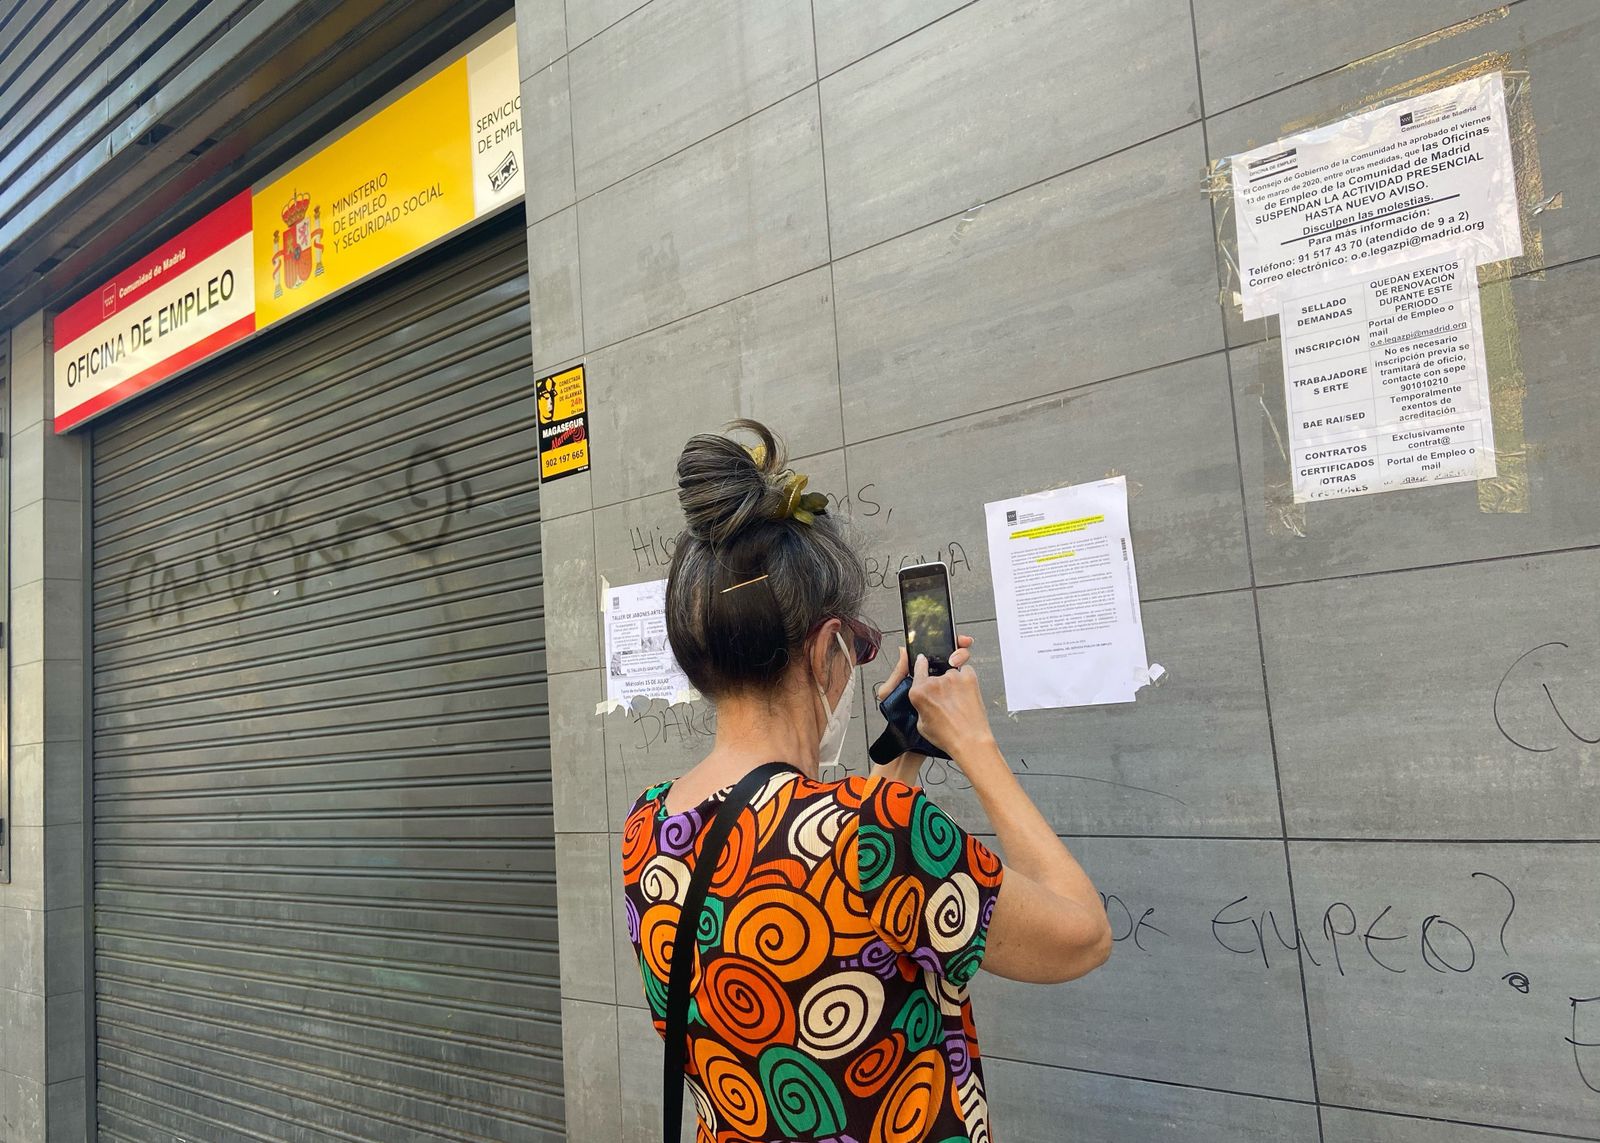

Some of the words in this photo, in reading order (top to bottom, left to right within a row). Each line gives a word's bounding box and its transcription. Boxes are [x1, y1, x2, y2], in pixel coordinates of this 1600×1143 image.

[1401, 117, 1440, 132] Comunidad
[1452, 106, 1477, 117] Madrid
[478, 135, 493, 154] DE
[495, 120, 522, 144] EMPL
[1252, 180, 1281, 193] Consejo
[1295, 165, 1329, 179] Gobierno
[1351, 143, 1395, 162] Comunidad
[1410, 128, 1448, 144] aprobado
[1461, 115, 1491, 129] viernes
[1268, 189, 1289, 199] marzo
[1302, 178, 1322, 188] 2020,
[1324, 171, 1343, 181] entre
[1346, 165, 1365, 175] otras
[1367, 154, 1403, 168] medidas,
[1405, 148, 1420, 157] que
[1422, 142, 1438, 152] las
[1442, 126, 1490, 146] Oficinas
[1277, 158, 1296, 167] EMPLEO
[1264, 202, 1276, 210] de
[1280, 189, 1318, 206] Empleo
[1321, 185, 1333, 193] de
[1337, 181, 1345, 189] la
[1349, 160, 1410, 186] Comunidad
[1414, 157, 1428, 166] de
[1432, 143, 1470, 161] Madrid
[333, 173, 388, 216] MINISTERIO
[1256, 198, 1321, 224] SUSPENDAN
[1325, 194, 1339, 204] LA
[1342, 175, 1403, 199] ACTIVIDAD
[1407, 152, 1484, 180] PRESENCIAL
[1306, 204, 1343, 221] HASTA
[1346, 192, 1386, 210] NUEVO
[1389, 181, 1428, 198] AVISO.
[333, 216, 346, 236] DE
[349, 193, 387, 226] EMPLEO
[333, 240, 339, 253] Y
[343, 206, 400, 250] SEGURIDAD
[404, 182, 444, 216] SOCIAL
[1303, 216, 1355, 235] Disculpen
[1358, 210, 1374, 220] las
[1377, 194, 1434, 215] molestias.
[1309, 235, 1332, 247] Para
[1335, 228, 1357, 240] más
[1361, 208, 1430, 233] información:
[1248, 259, 1295, 276] Teléfono:
[1298, 253, 1309, 262] 91
[1314, 247, 1331, 259] 517
[1335, 243, 1347, 252] 43
[1350, 239, 1362, 249] 70
[1366, 226, 1417, 247] (atendido
[1421, 222, 1435, 230] de
[1438, 217, 1444, 226] 9
[1459, 211, 1469, 221] 2)
[1249, 273, 1283, 287] Correo
[1286, 256, 1348, 278] electrónico:
[1351, 221, 1485, 260] o.e.legazpi@madrid.org
[119, 269, 153, 299] Comunidad
[154, 266, 162, 277] de
[163, 248, 186, 271] Madrid
[1370, 273, 1410, 289] QUEDAN
[1413, 262, 1459, 279] EXENTOS
[1376, 288, 1389, 298] DE
[1391, 273, 1455, 294] RENOVACIÓN
[1380, 290, 1425, 306] DURANTE
[1428, 283, 1453, 296] ESTE
[1302, 298, 1346, 314] SELLADO
[1395, 297, 1439, 312] PERIODO
[1297, 308, 1353, 326] DEMANDAS
[1369, 316, 1395, 328] Portal
[1398, 314, 1408, 322] de
[1411, 306, 1446, 319] Empleo
[66, 333, 126, 388] OFICINA
[131, 315, 152, 352] DE
[158, 269, 234, 338] EMPLEO
[1370, 328, 1388, 338] mail
[1370, 322, 1467, 348] o.e.legazpi@madrid.org
[1295, 335, 1360, 355] INSCRIPCIÓN
[1385, 348, 1397, 356] No
[1413, 336, 1458, 350] necesario
[1375, 354, 1425, 367] inscripción
[1428, 346, 1456, 358] previa
[1380, 363, 1420, 376] tramitará
[1437, 355, 1466, 365] oficio,
[559, 375, 581, 387] CONECTADA
[1293, 367, 1368, 388] TRABAJADORE
[1382, 373, 1421, 385] contacte
[1424, 369, 1441, 378] con
[1444, 364, 1466, 375] sepe
[1400, 376, 1449, 392] 901010210
[564, 384, 580, 392] CENTRAL
[565, 390, 582, 400] ALARMAS
[1323, 382, 1349, 394] ERTE
[1391, 385, 1462, 403] Temporalmente
[571, 398, 582, 407] 24h
[1402, 400, 1438, 411] exentos
[1440, 397, 1452, 405] de
[1303, 420, 1323, 429] BAE
[1326, 412, 1366, 425] RAI/SED
[1399, 406, 1456, 422] acreditación
[543, 418, 584, 438] MAGASEGUR
[1392, 425, 1465, 442] Exclusivamente
[1305, 444, 1367, 461] CONTRATOS
[1408, 436, 1451, 449] contrat@
[546, 458, 557, 468] 902
[559, 454, 570, 463] 197
[572, 449, 584, 460] 665
[1301, 459, 1375, 476] CERTIFICADOS
[1387, 456, 1414, 466] Portal
[1431, 449, 1466, 460] Empleo
[1422, 462, 1441, 471] mail
